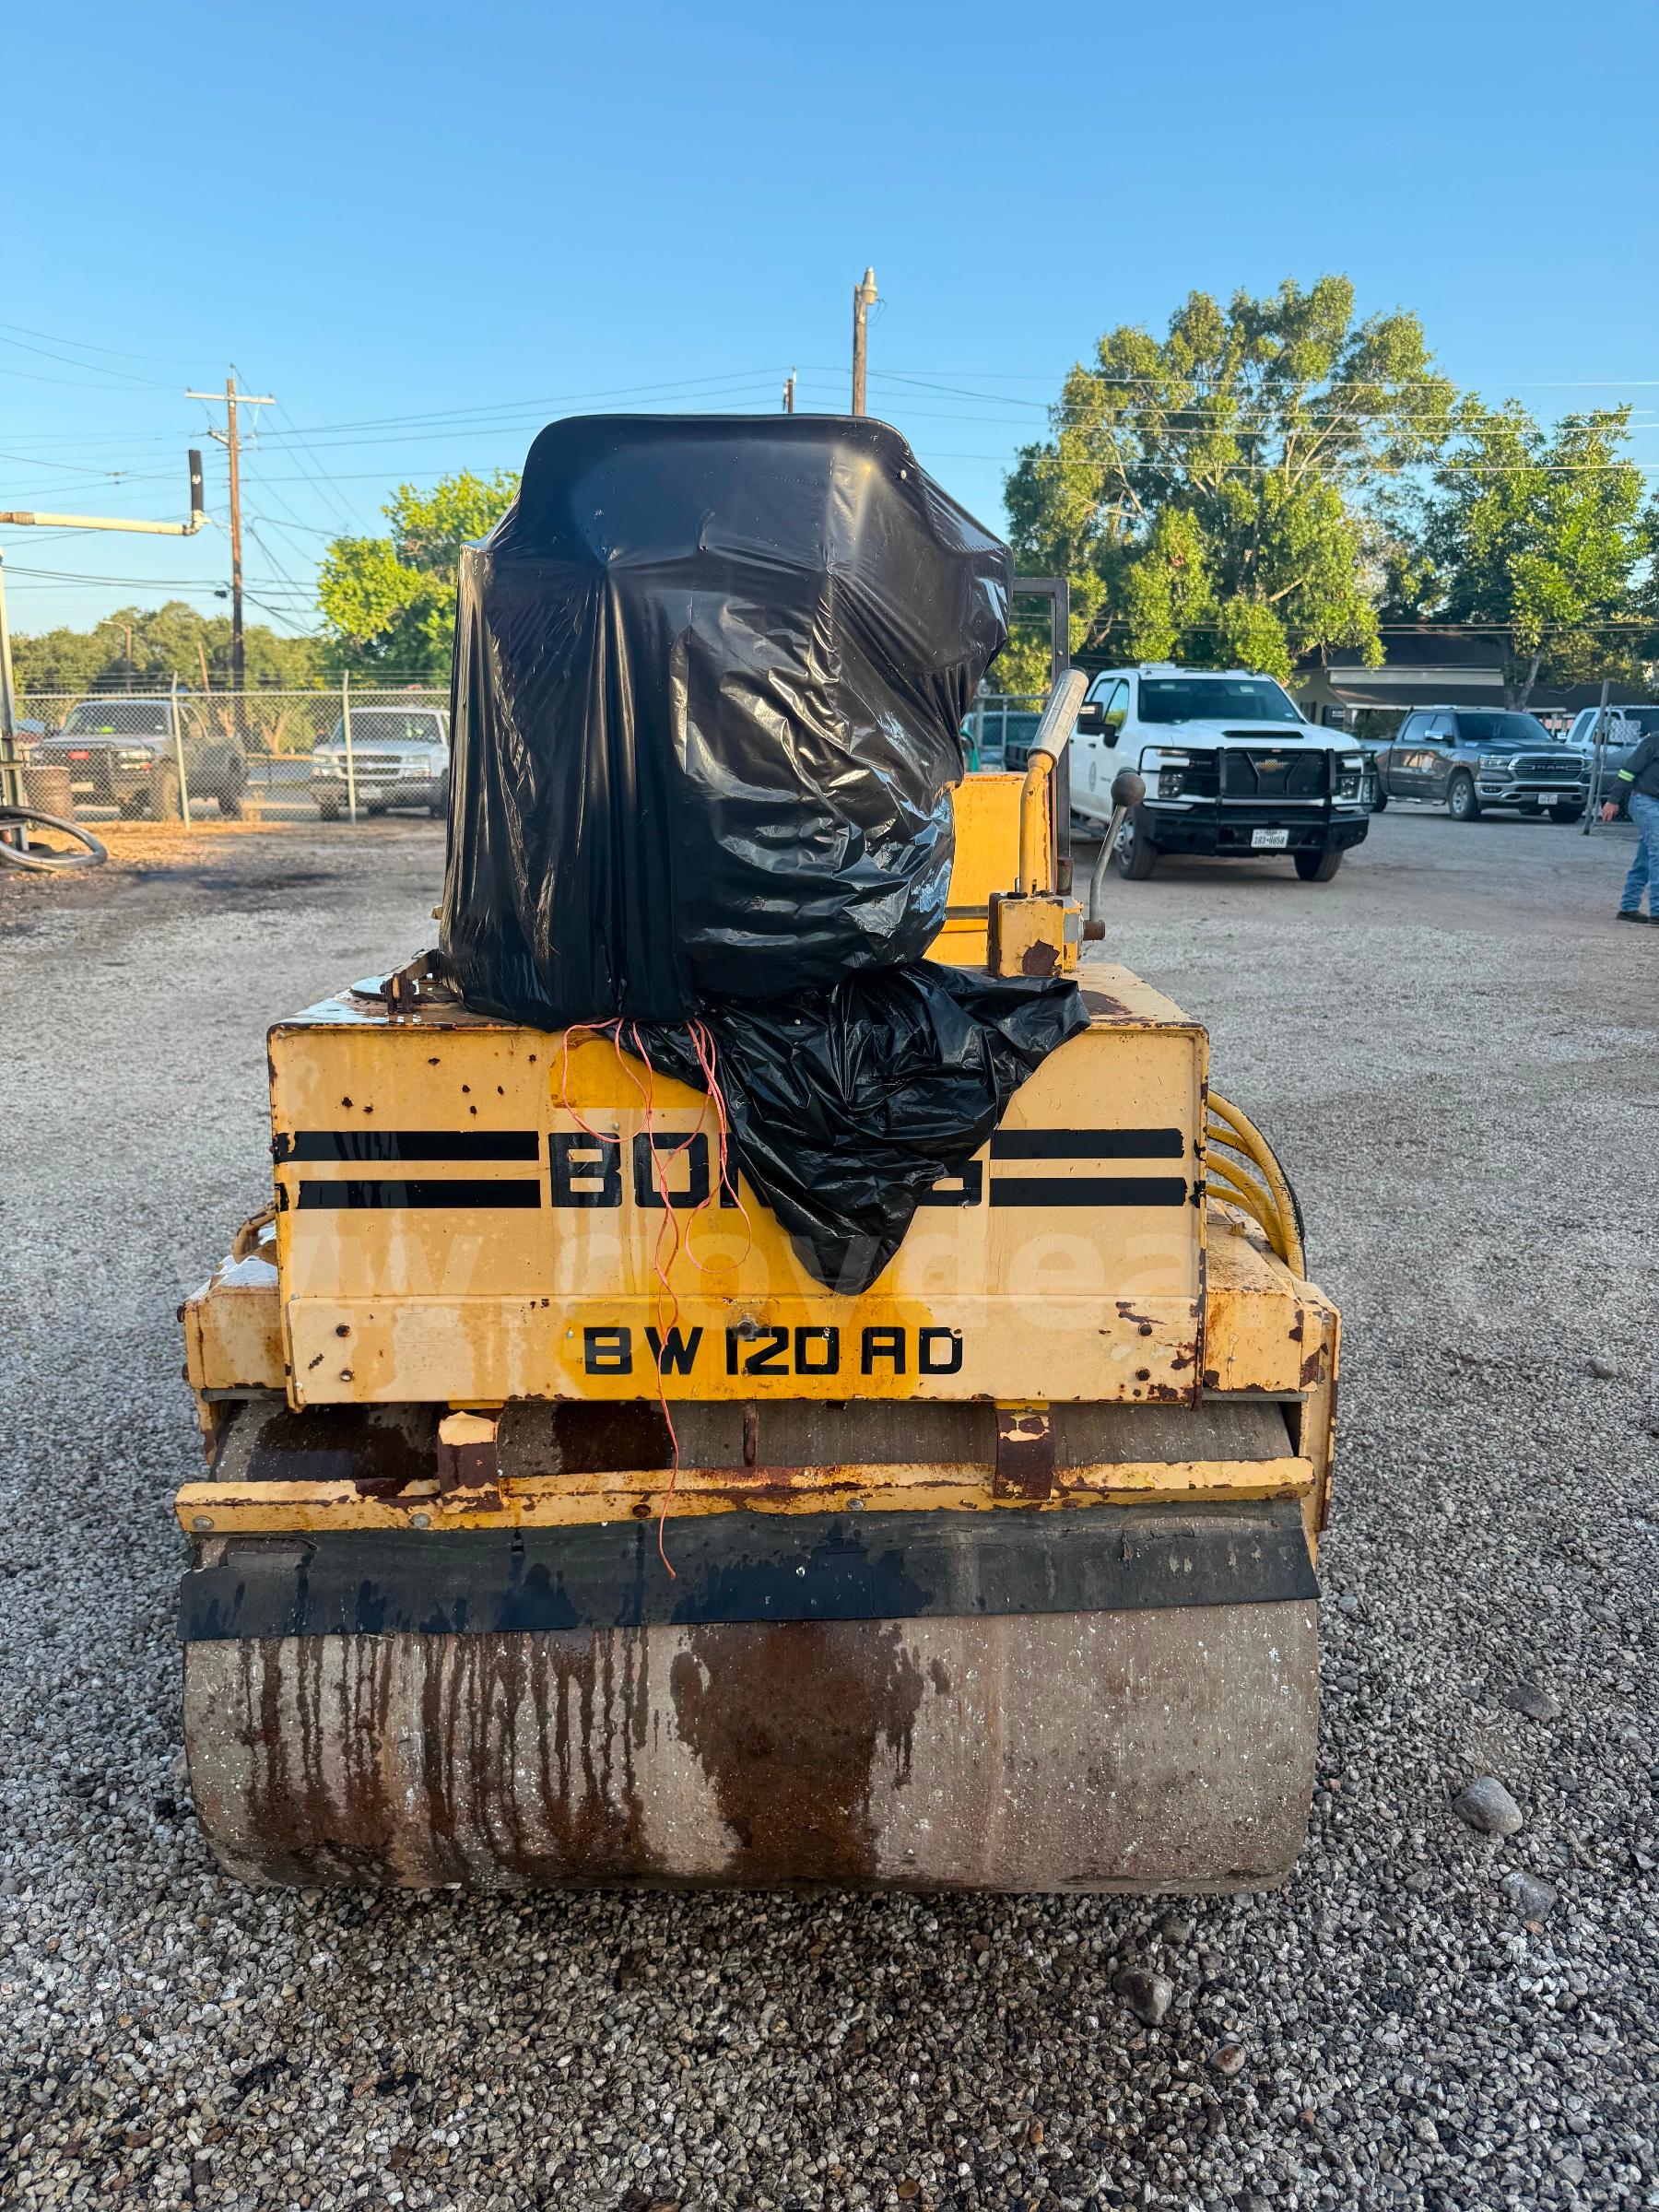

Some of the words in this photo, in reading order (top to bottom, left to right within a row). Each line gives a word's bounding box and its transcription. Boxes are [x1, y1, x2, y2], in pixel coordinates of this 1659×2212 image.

[583, 1327, 703, 1375] BW
[725, 1327, 840, 1375] 120
[861, 1327, 963, 1375] AD
